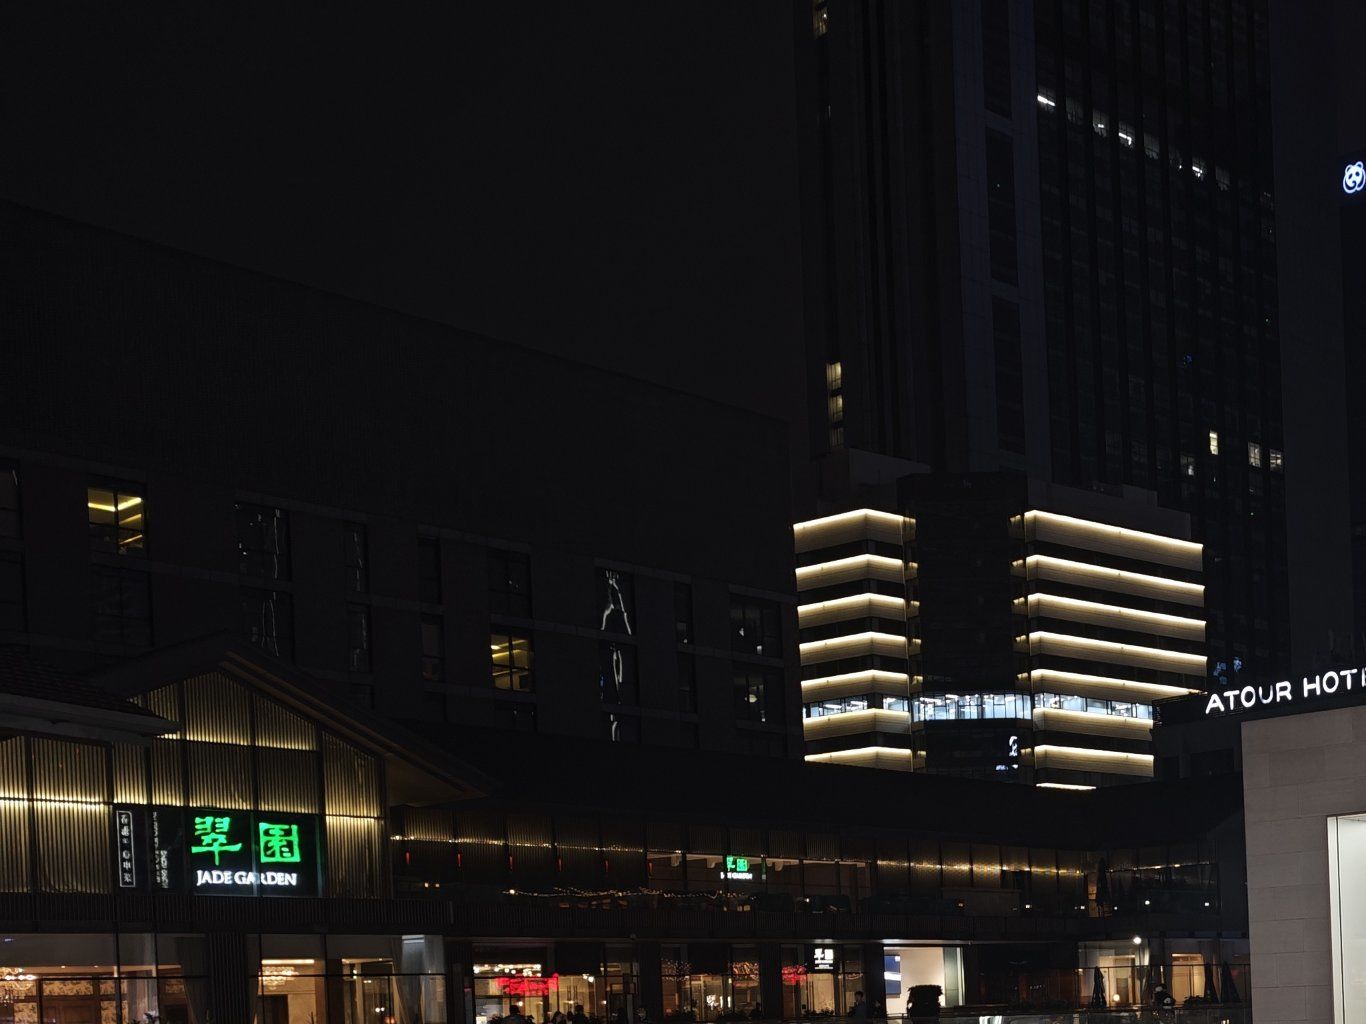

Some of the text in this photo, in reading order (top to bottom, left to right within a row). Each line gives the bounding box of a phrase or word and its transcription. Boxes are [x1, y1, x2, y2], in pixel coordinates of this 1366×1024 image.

[1205, 680, 1292, 715] ATOUR
[196, 870, 298, 886] JADE GARDEN
